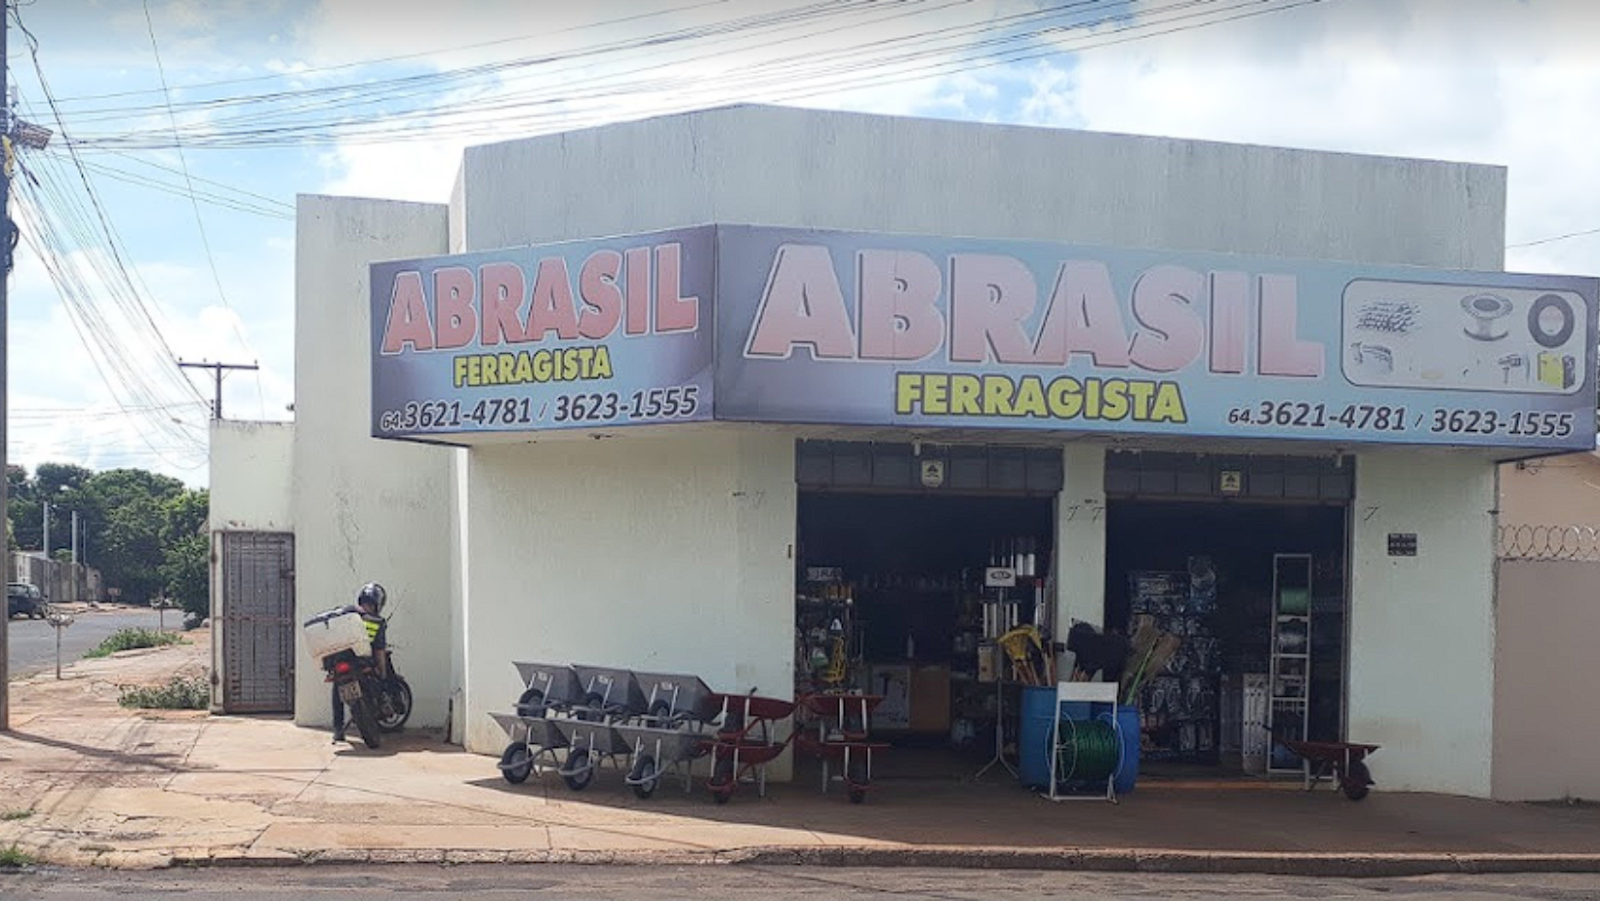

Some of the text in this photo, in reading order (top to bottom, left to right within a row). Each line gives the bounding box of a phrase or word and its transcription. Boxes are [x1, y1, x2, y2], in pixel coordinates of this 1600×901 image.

[381, 243, 698, 355] ABRASIL
[743, 243, 1325, 378] ABRASIL
[453, 345, 613, 387] FERRAGISTA
[554, 387, 698, 422] 3623-1555
[895, 371, 1188, 423] FERRAGISTA
[1430, 408, 1574, 436] 3623-1555
